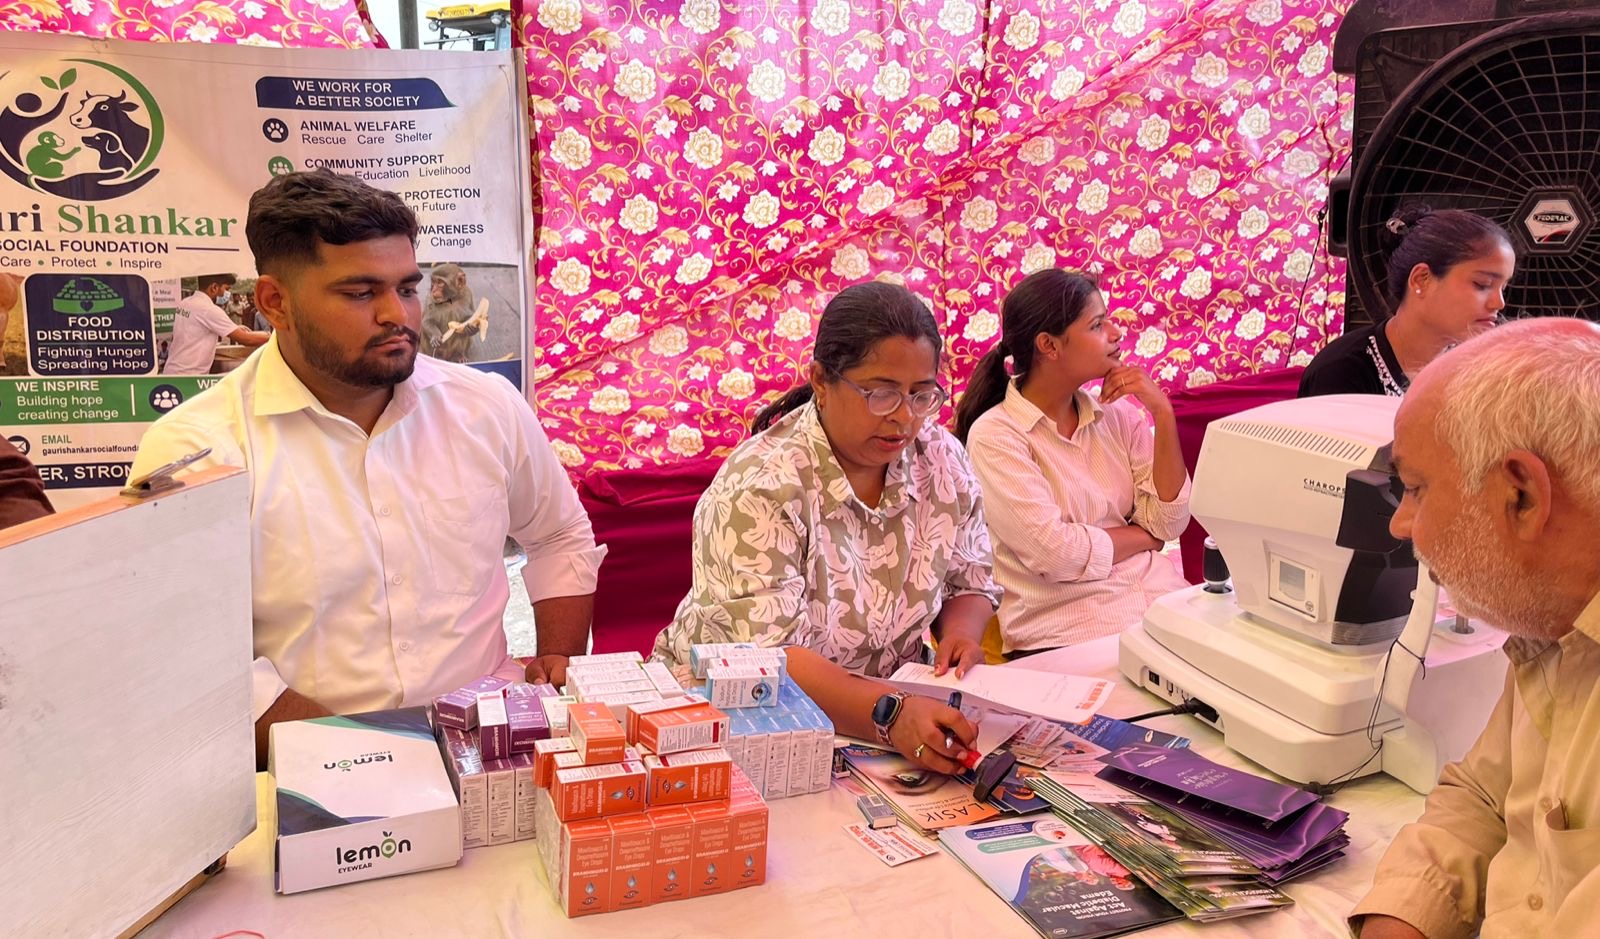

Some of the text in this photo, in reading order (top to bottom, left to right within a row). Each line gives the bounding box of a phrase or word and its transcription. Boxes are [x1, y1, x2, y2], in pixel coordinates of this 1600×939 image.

[292, 80, 392, 93] WE WORK FOR
[295, 95, 421, 107] A BETTER SOCIETY
[300, 120, 416, 132] ANIMAL WELFARE
[301, 131, 433, 145] Rescue Care Shelter
[304, 154, 445, 169] COMMUNITY SUPPORT
[354, 164, 472, 181] Education Livelihood
[404, 188, 481, 201] PROTECTION
[422, 202, 456, 212] Future
[0, 203, 238, 237] ri Shankar
[418, 224, 484, 235] WARENESS
[60, 240, 169, 254] FOUNDATION
[430, 237, 472, 249] Change
[0, 256, 162, 270] Care Protect Inspire
[68, 316, 112, 327] FOOD
[36, 330, 145, 342] DISTRIBUTION
[38, 346, 147, 359] Fighting Hunger
[38, 359, 149, 372] Spreading Hope
[15, 380, 100, 393] WE INSPIRE
[17, 395, 103, 408] Building hope
[18, 408, 119, 422] creating change
[41, 434, 72, 445] EMAIL
[323, 754, 393, 770] lemon
[920, 802, 985, 822] LASIK
[336, 835, 412, 865] lemon
[338, 863, 373, 874] EYEWEAR
[1080, 890, 1114, 899] Edema
[1042, 896, 1121, 913] Diabetic Macular
[1069, 905, 1108, 916] Against
